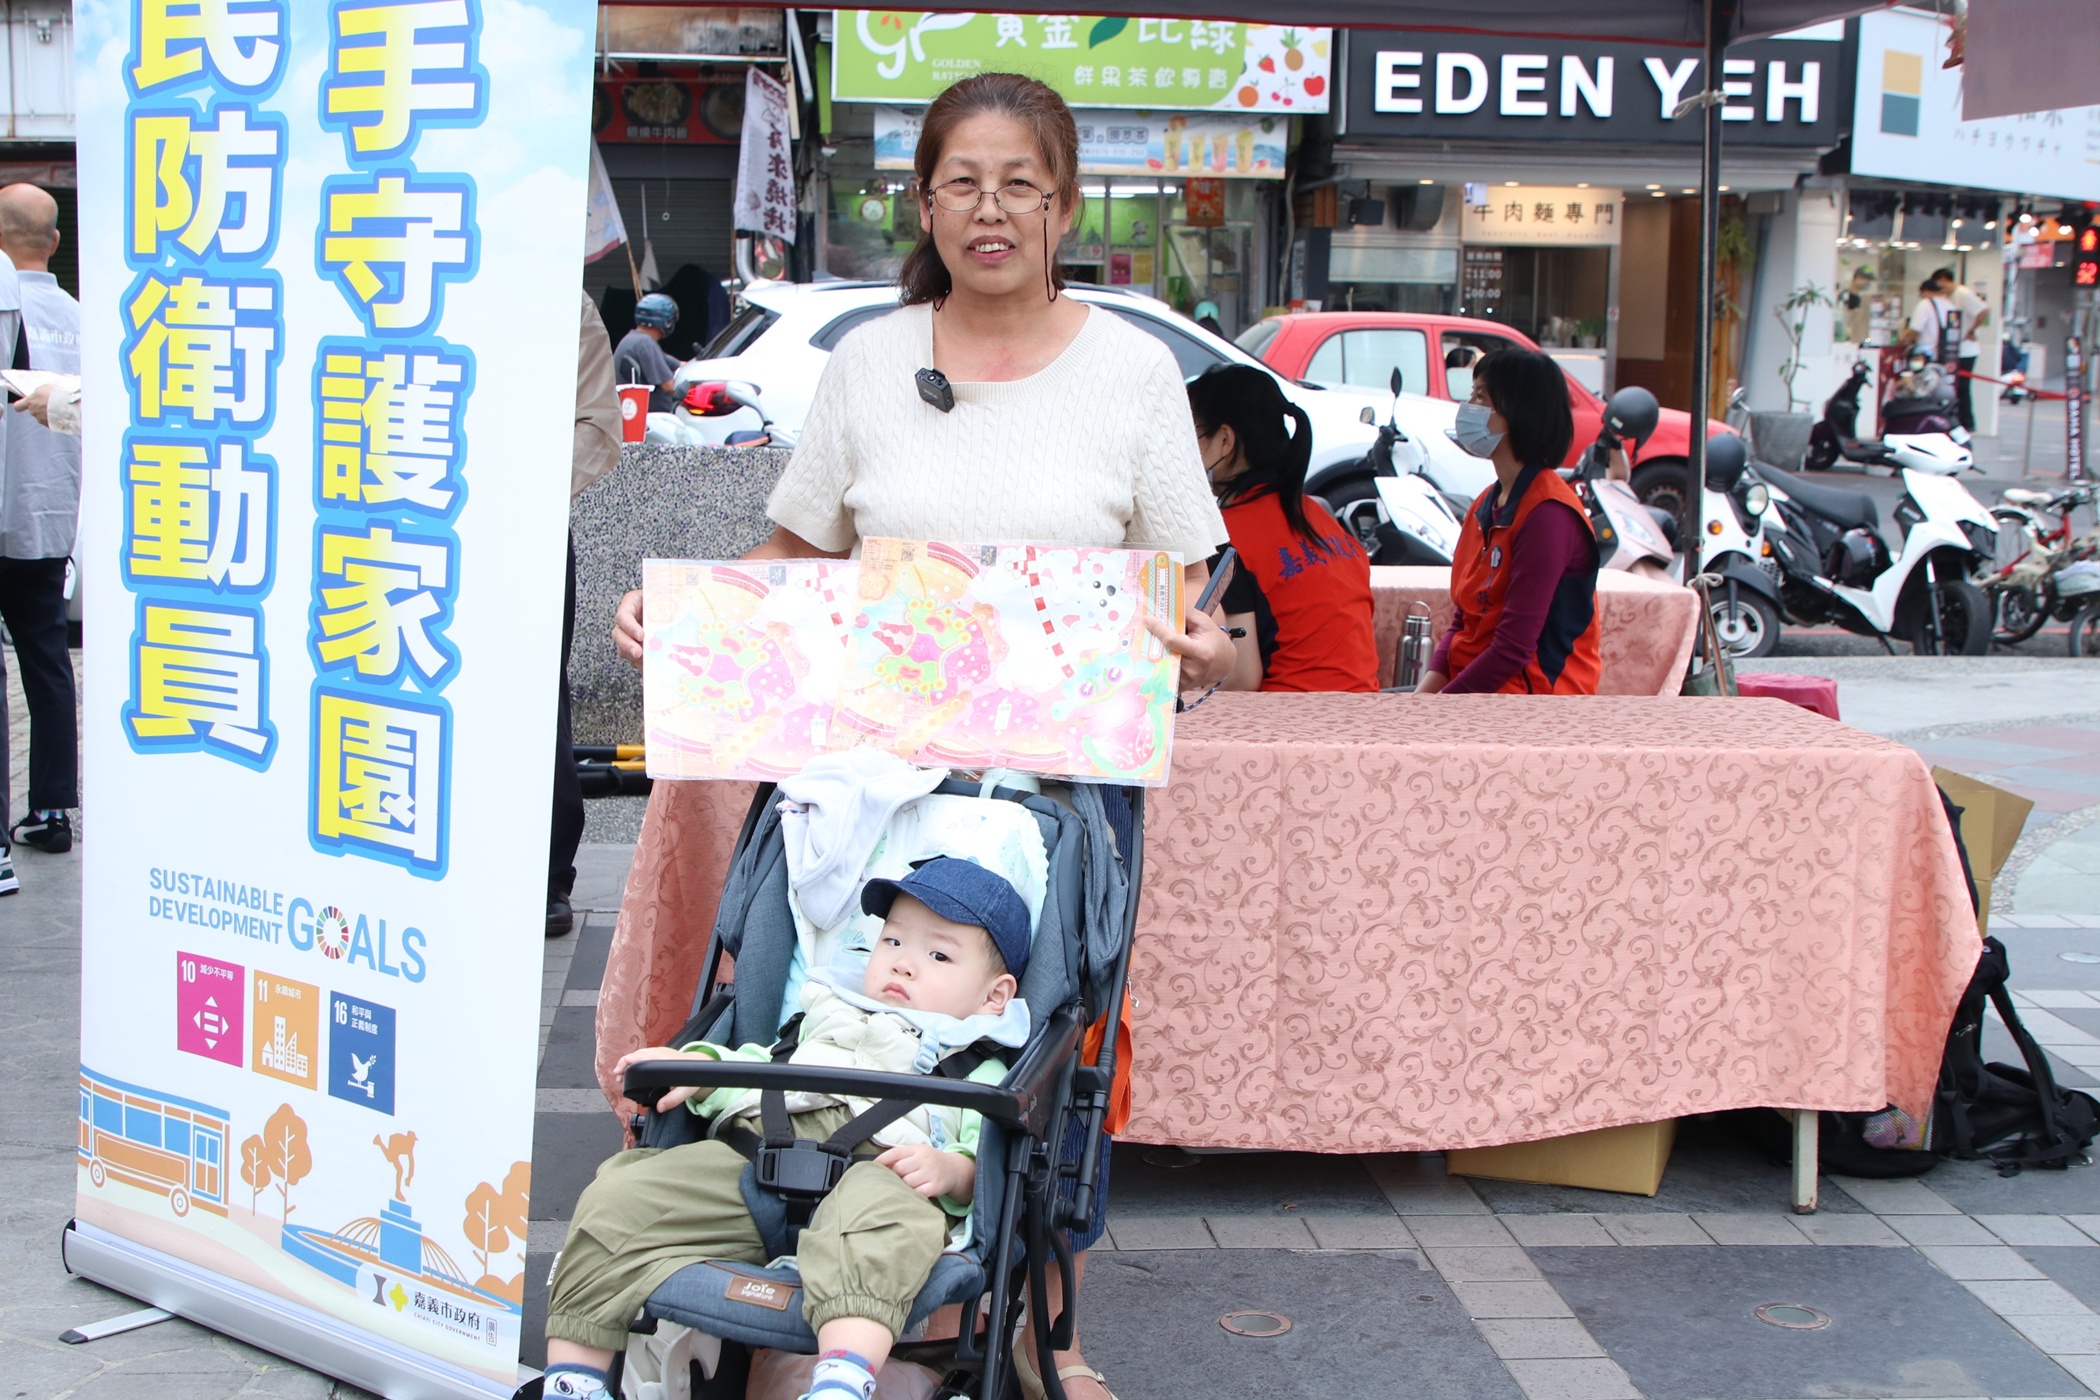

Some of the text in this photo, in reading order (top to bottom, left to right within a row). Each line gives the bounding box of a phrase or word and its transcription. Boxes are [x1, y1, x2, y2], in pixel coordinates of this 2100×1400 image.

[1374, 51, 1821, 123] EDEN YEH
[1473, 201, 1615, 225] 牛肉麵專門
[129, 0, 281, 756] 民防衛動員
[318, 0, 477, 863] 手守護家園
[149, 867, 284, 917] SUSTAINABLE
[149, 895, 283, 945] DEVELOPMENT
[287, 897, 427, 984] GOALS
[181, 960, 196, 983] 10
[258, 979, 268, 1002] 11
[334, 1000, 348, 1025] 16
[413, 1290, 481, 1331] 嘉義市政府
[432, 1319, 444, 1328] CITY
[444, 1324, 481, 1342] GOVERNMENT
